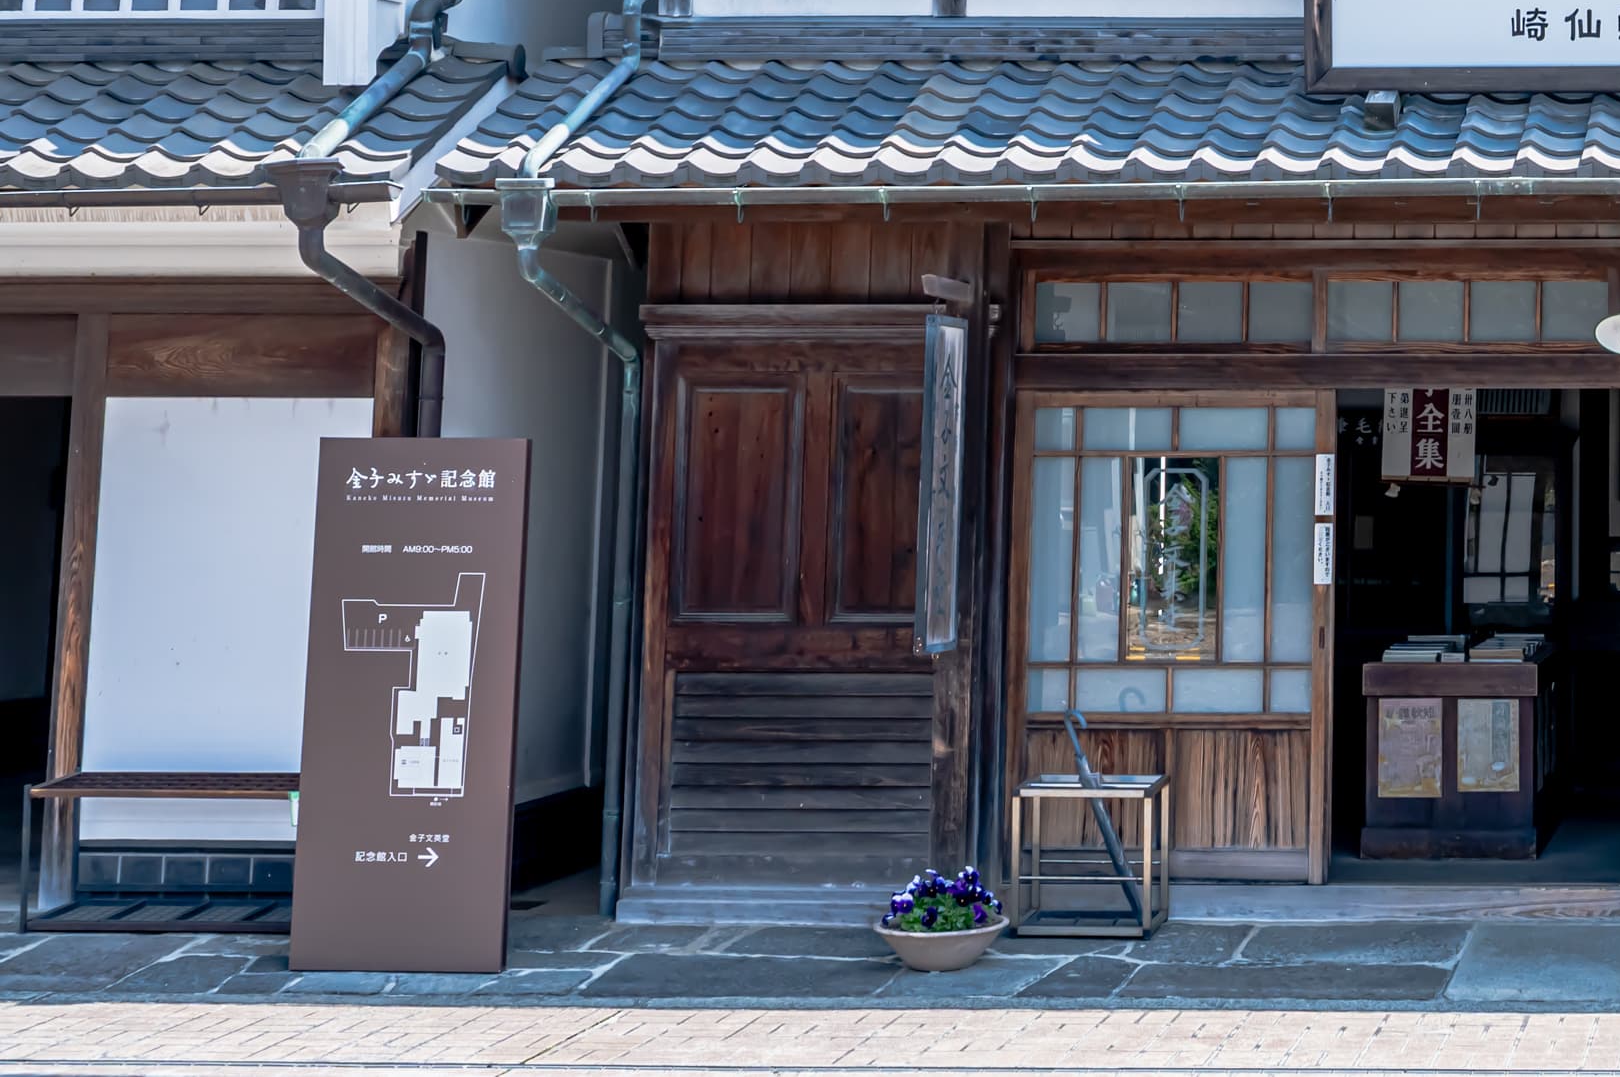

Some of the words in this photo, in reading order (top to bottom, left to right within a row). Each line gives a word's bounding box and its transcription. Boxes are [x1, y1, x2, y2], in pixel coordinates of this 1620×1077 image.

[1415, 389, 1445, 469] 全集
[346, 467, 496, 489] 金子みすゞ記念館
[379, 614, 388, 623] P
[409, 834, 450, 843] 金子文英堂
[355, 851, 408, 862] 記念館入口
